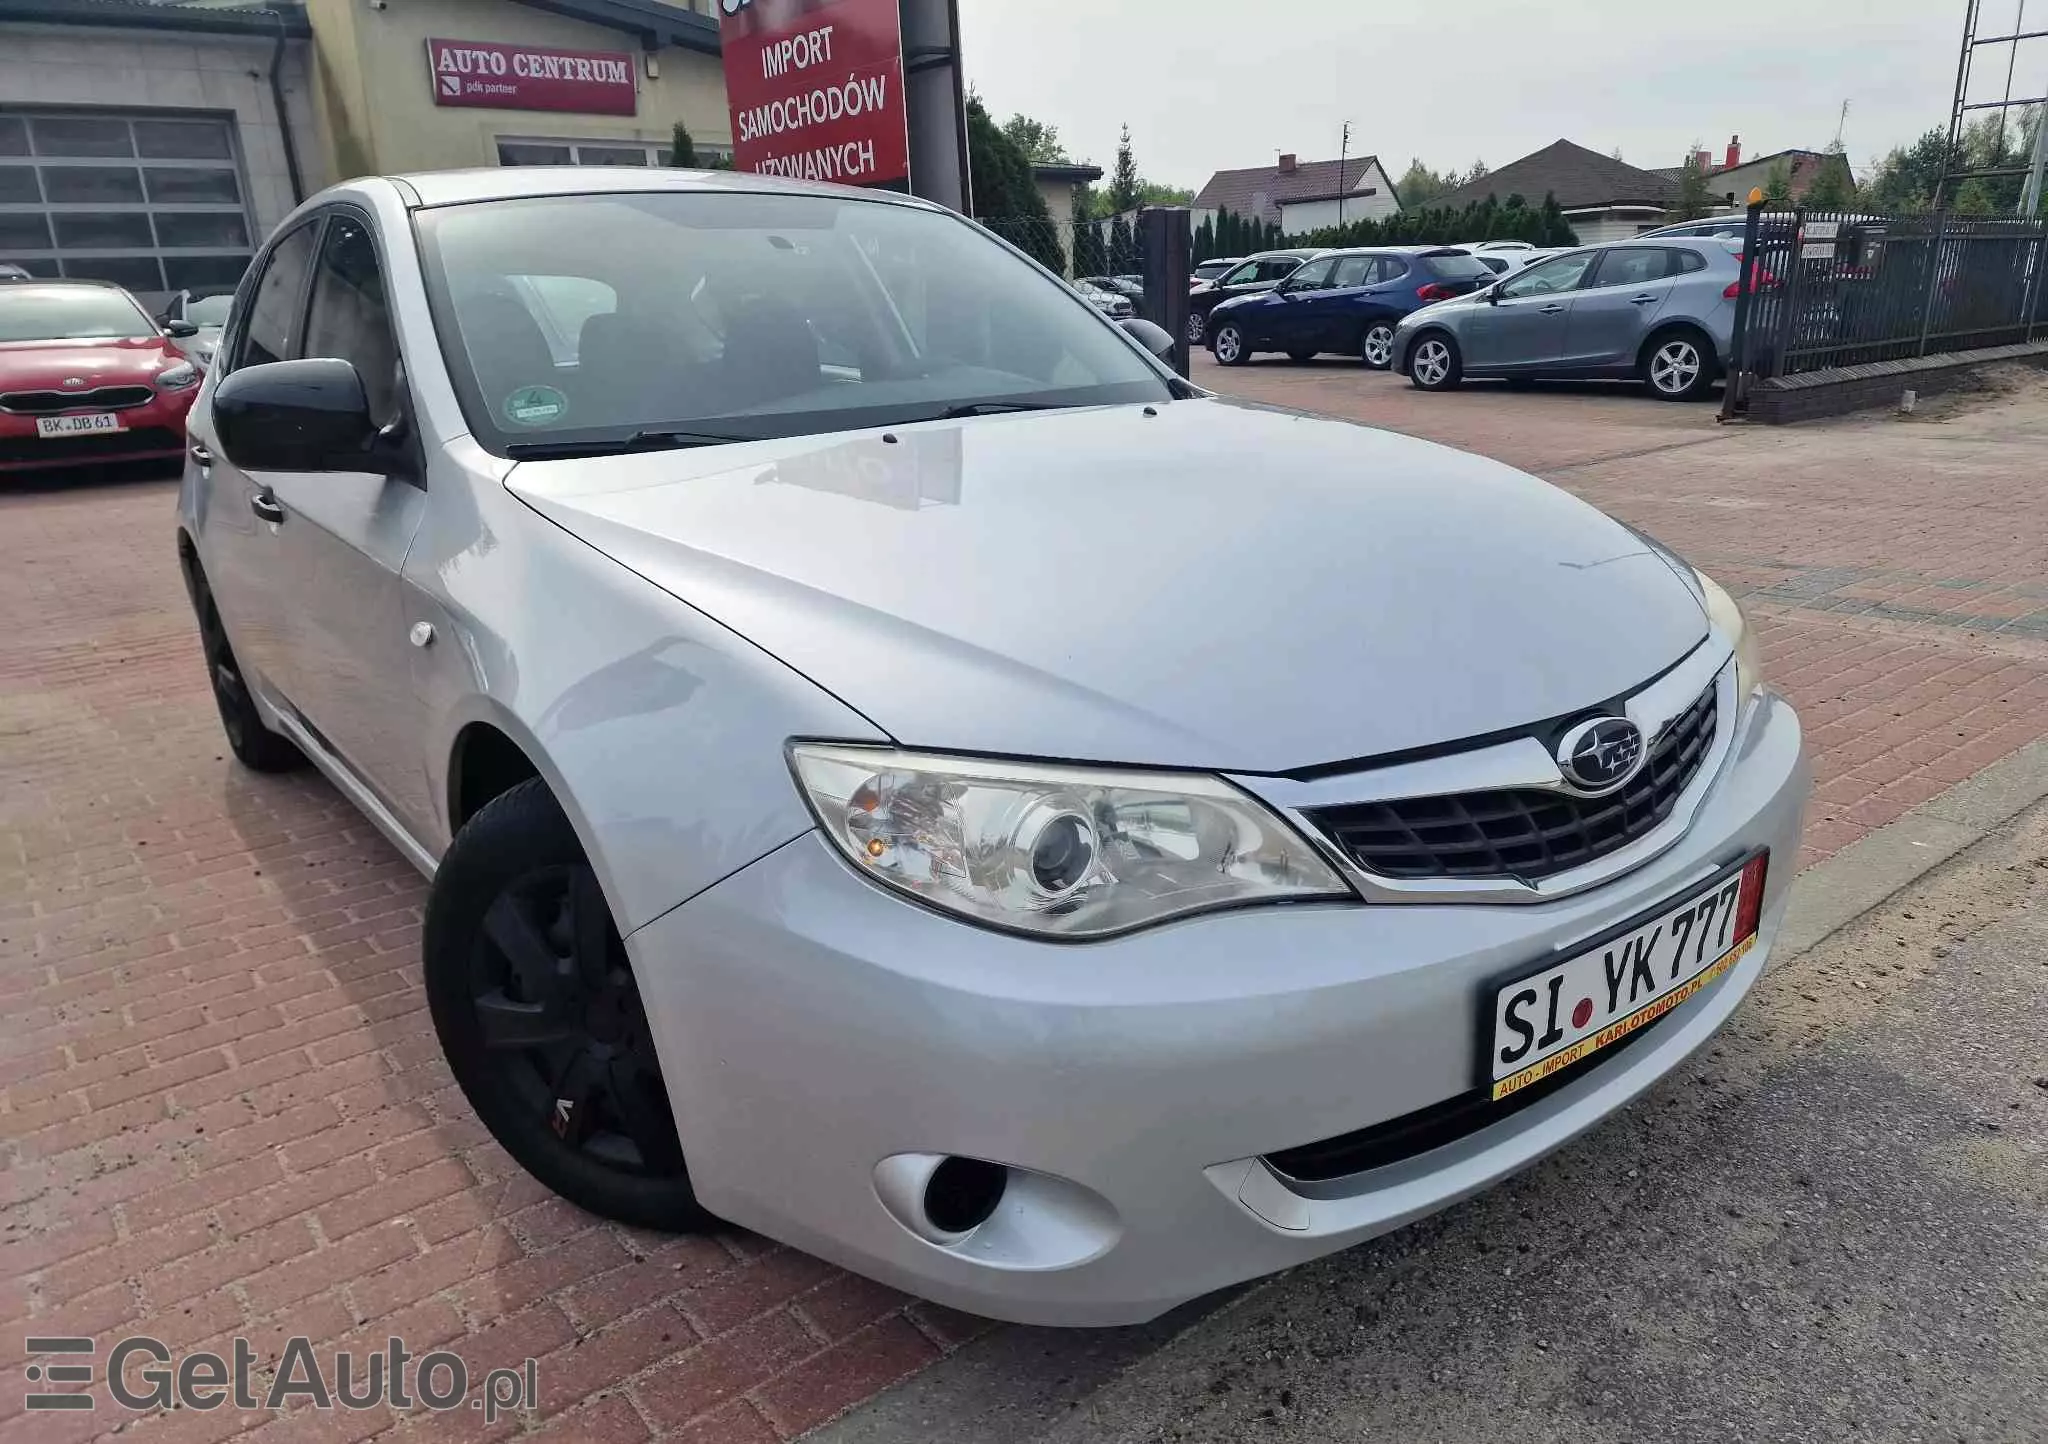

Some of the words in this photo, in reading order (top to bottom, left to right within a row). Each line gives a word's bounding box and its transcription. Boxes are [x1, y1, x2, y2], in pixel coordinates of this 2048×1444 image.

[437, 48, 507, 76] AUTO
[512, 53, 630, 84] CENTRUM
[761, 25, 833, 79] IMPORT
[738, 73, 886, 142] SAMOCHODÓW
[43, 419, 64, 433] BK
[94, 415, 113, 429] 61
[1500, 974, 1564, 1064] SI
[1604, 925, 1663, 1014] YK
[1671, 879, 1741, 979] 777
[1500, 1070, 1533, 1097] AUTO
[1543, 1044, 1585, 1076] IMPORT
[1595, 978, 1704, 1049] KARI.OTOMOTO.PL
